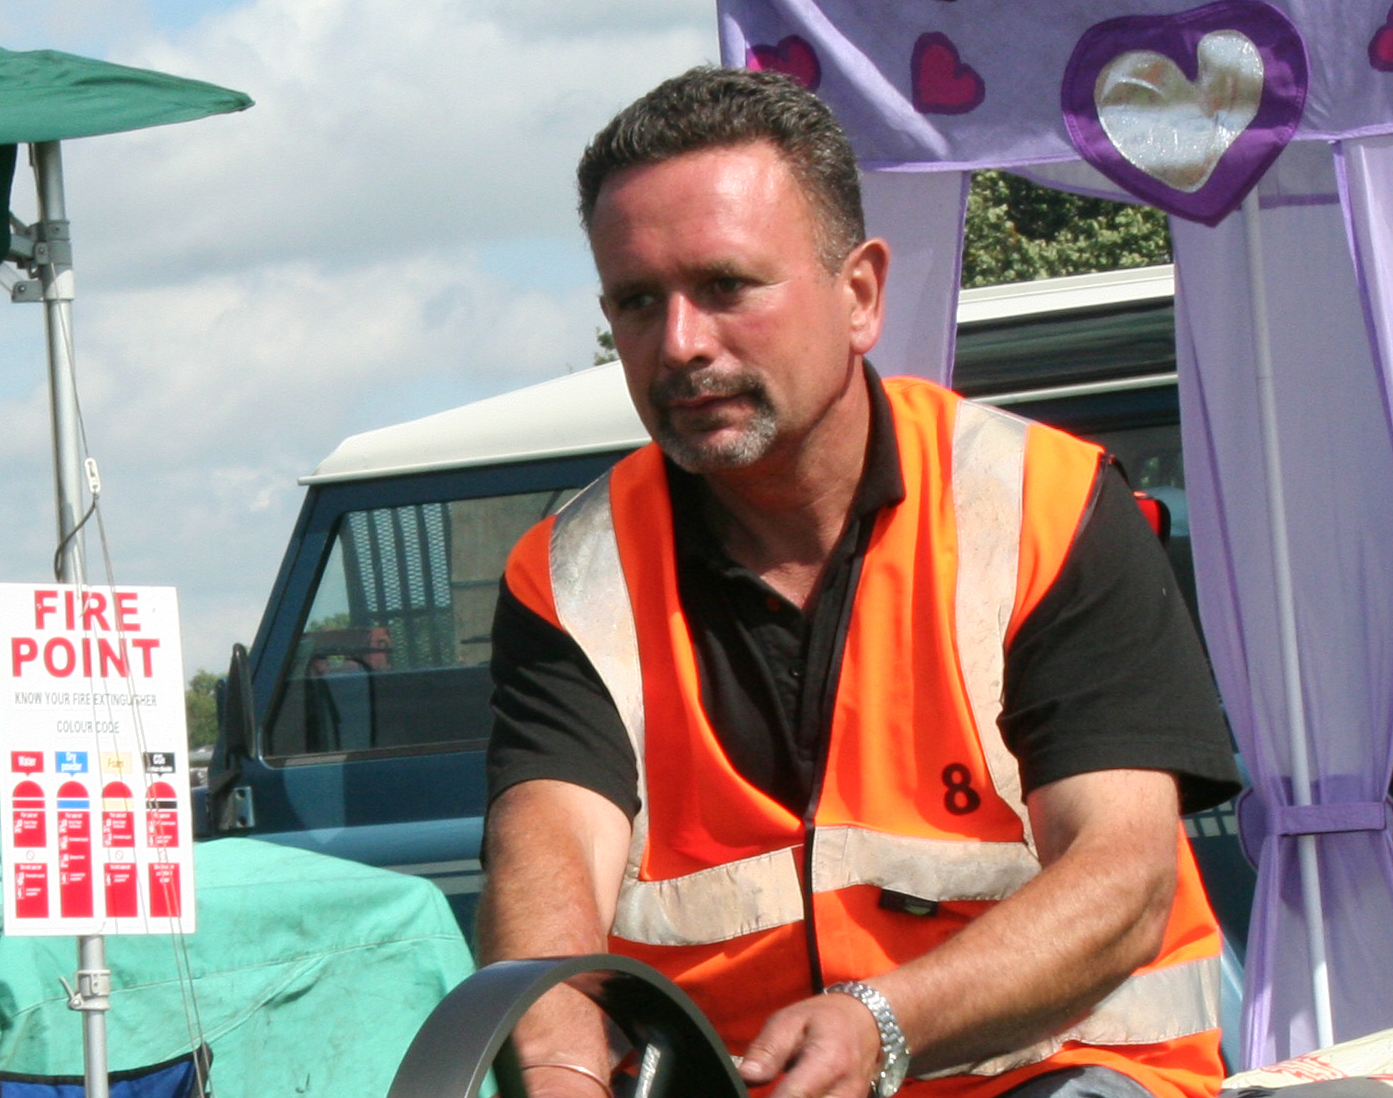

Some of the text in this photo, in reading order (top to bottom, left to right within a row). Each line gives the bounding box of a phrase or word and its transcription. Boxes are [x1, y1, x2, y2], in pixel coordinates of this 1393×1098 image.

[34, 590, 141, 631] FIRE
[11, 637, 160, 678] POINT
[14, 691, 157, 707] KNOW YOUR FIRE EXTINGUSHER
[57, 720, 120, 734] COLOUR CODE
[942, 763, 981, 815] 8
